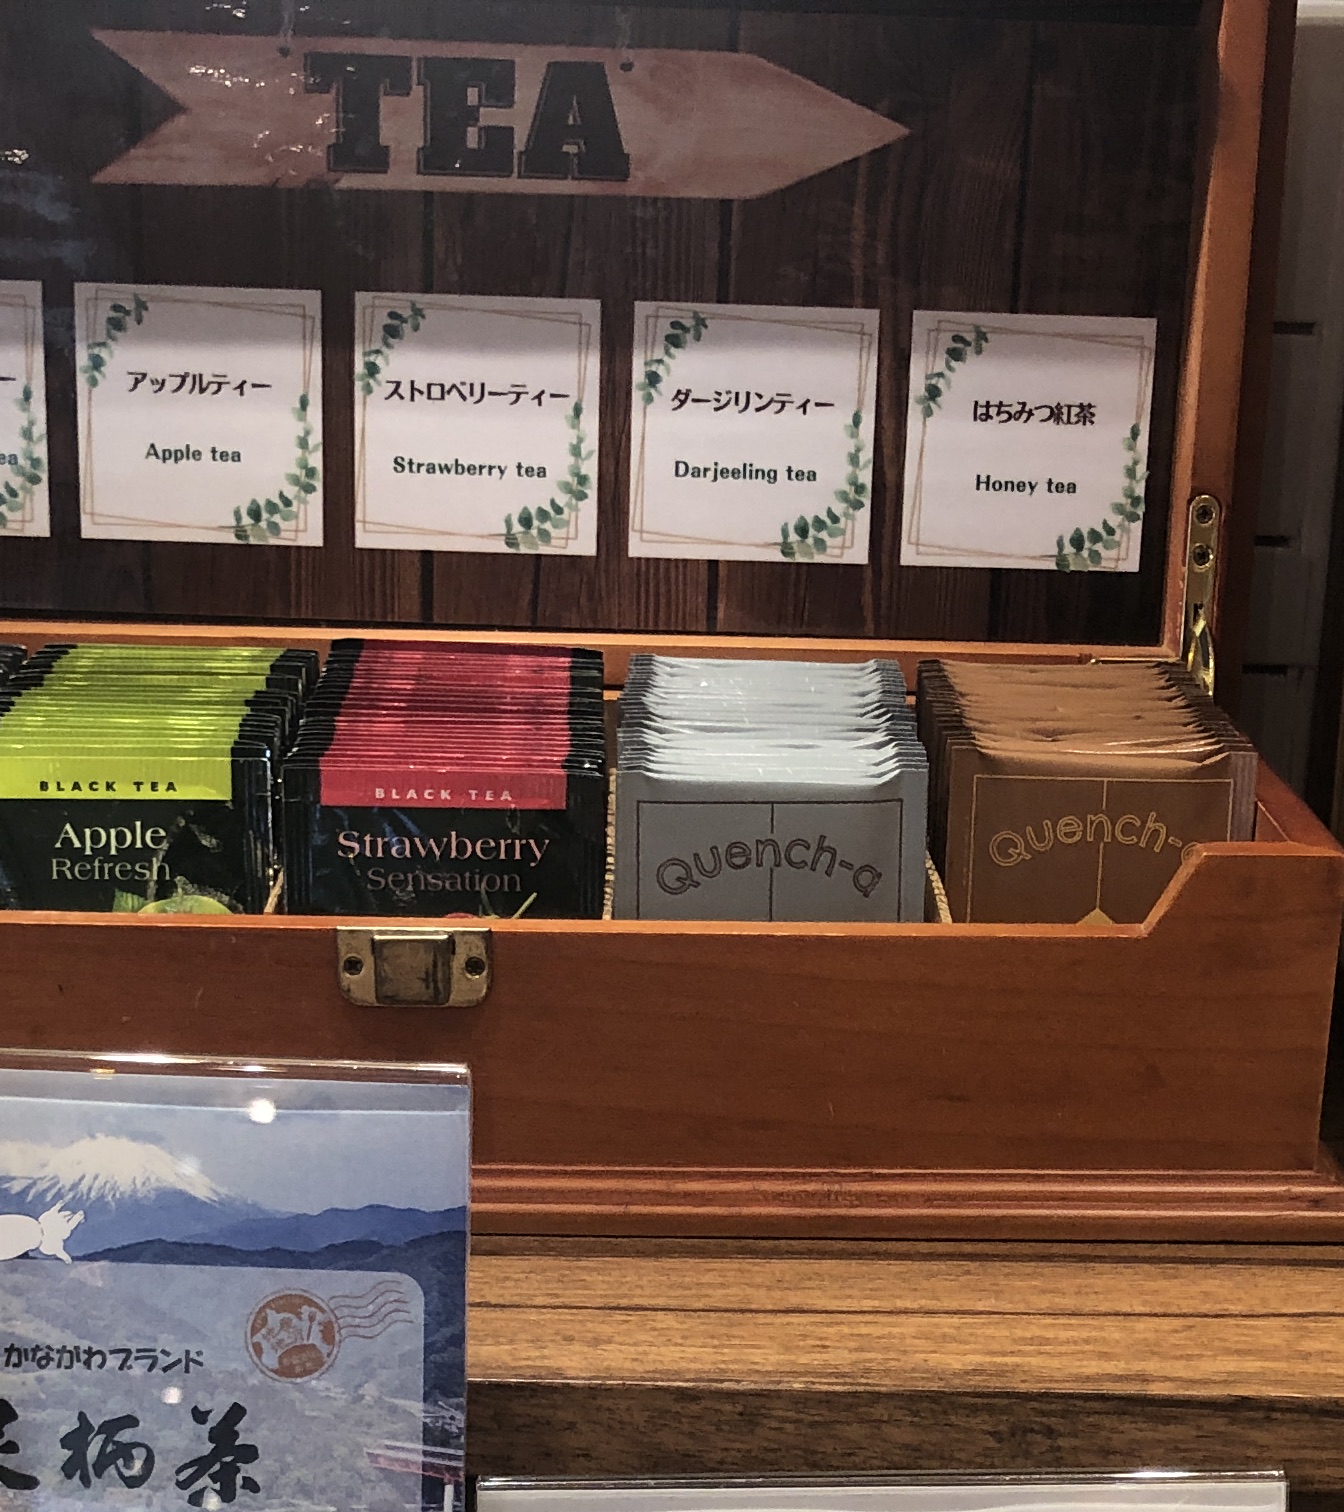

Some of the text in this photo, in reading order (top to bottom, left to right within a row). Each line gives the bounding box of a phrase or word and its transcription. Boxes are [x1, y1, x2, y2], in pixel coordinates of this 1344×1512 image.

[304, 50, 631, 180] TEA
[127, 371, 272, 397] アップルティー
[383, 379, 570, 407] ストロベリーティー
[671, 387, 835, 415] ダージリンティー
[972, 399, 1097, 427] はちみつ紅茶
[145, 443, 242, 466] Apple tea
[393, 457, 548, 480] Strawberry tea
[674, 460, 818, 484] Darjeeling tea
[976, 474, 1077, 498] Honey tea
[39, 780, 177, 792] BLACK TEA
[375, 787, 512, 801] BLACK TEA
[54, 820, 167, 856] Apple
[337, 830, 550, 867] Strawberry
[51, 856, 171, 881] Refresh
[656, 834, 882, 898] Quench-a
[366, 867, 522, 892] Sensation
[3, 1342, 204, 1374] かながわブランド
